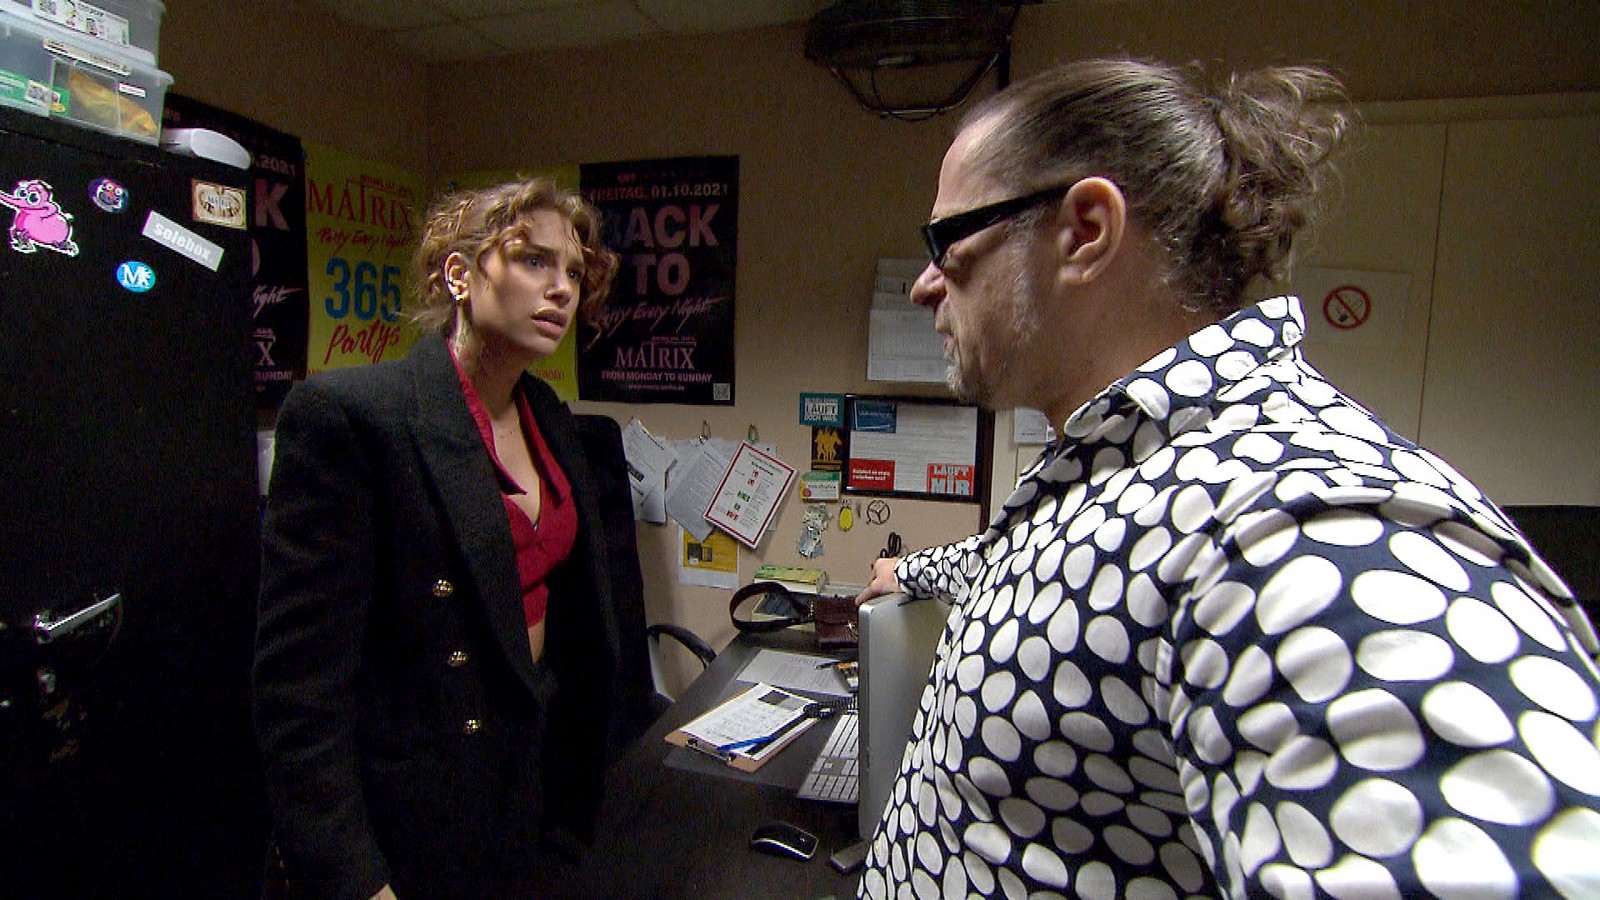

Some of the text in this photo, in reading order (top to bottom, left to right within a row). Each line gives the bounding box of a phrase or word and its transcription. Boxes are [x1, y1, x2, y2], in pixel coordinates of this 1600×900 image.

[307, 177, 413, 231] MATRIX
[651, 182, 728, 199] 01.10.2021
[154, 222, 211, 260] solebox
[325, 257, 401, 322] 365
[632, 252, 691, 295] TO
[324, 318, 400, 365] Partys
[616, 342, 696, 370] MATRIX
[601, 370, 713, 383] FROM MONDAY TO SUNDAY
[931, 477, 970, 495] MIR
